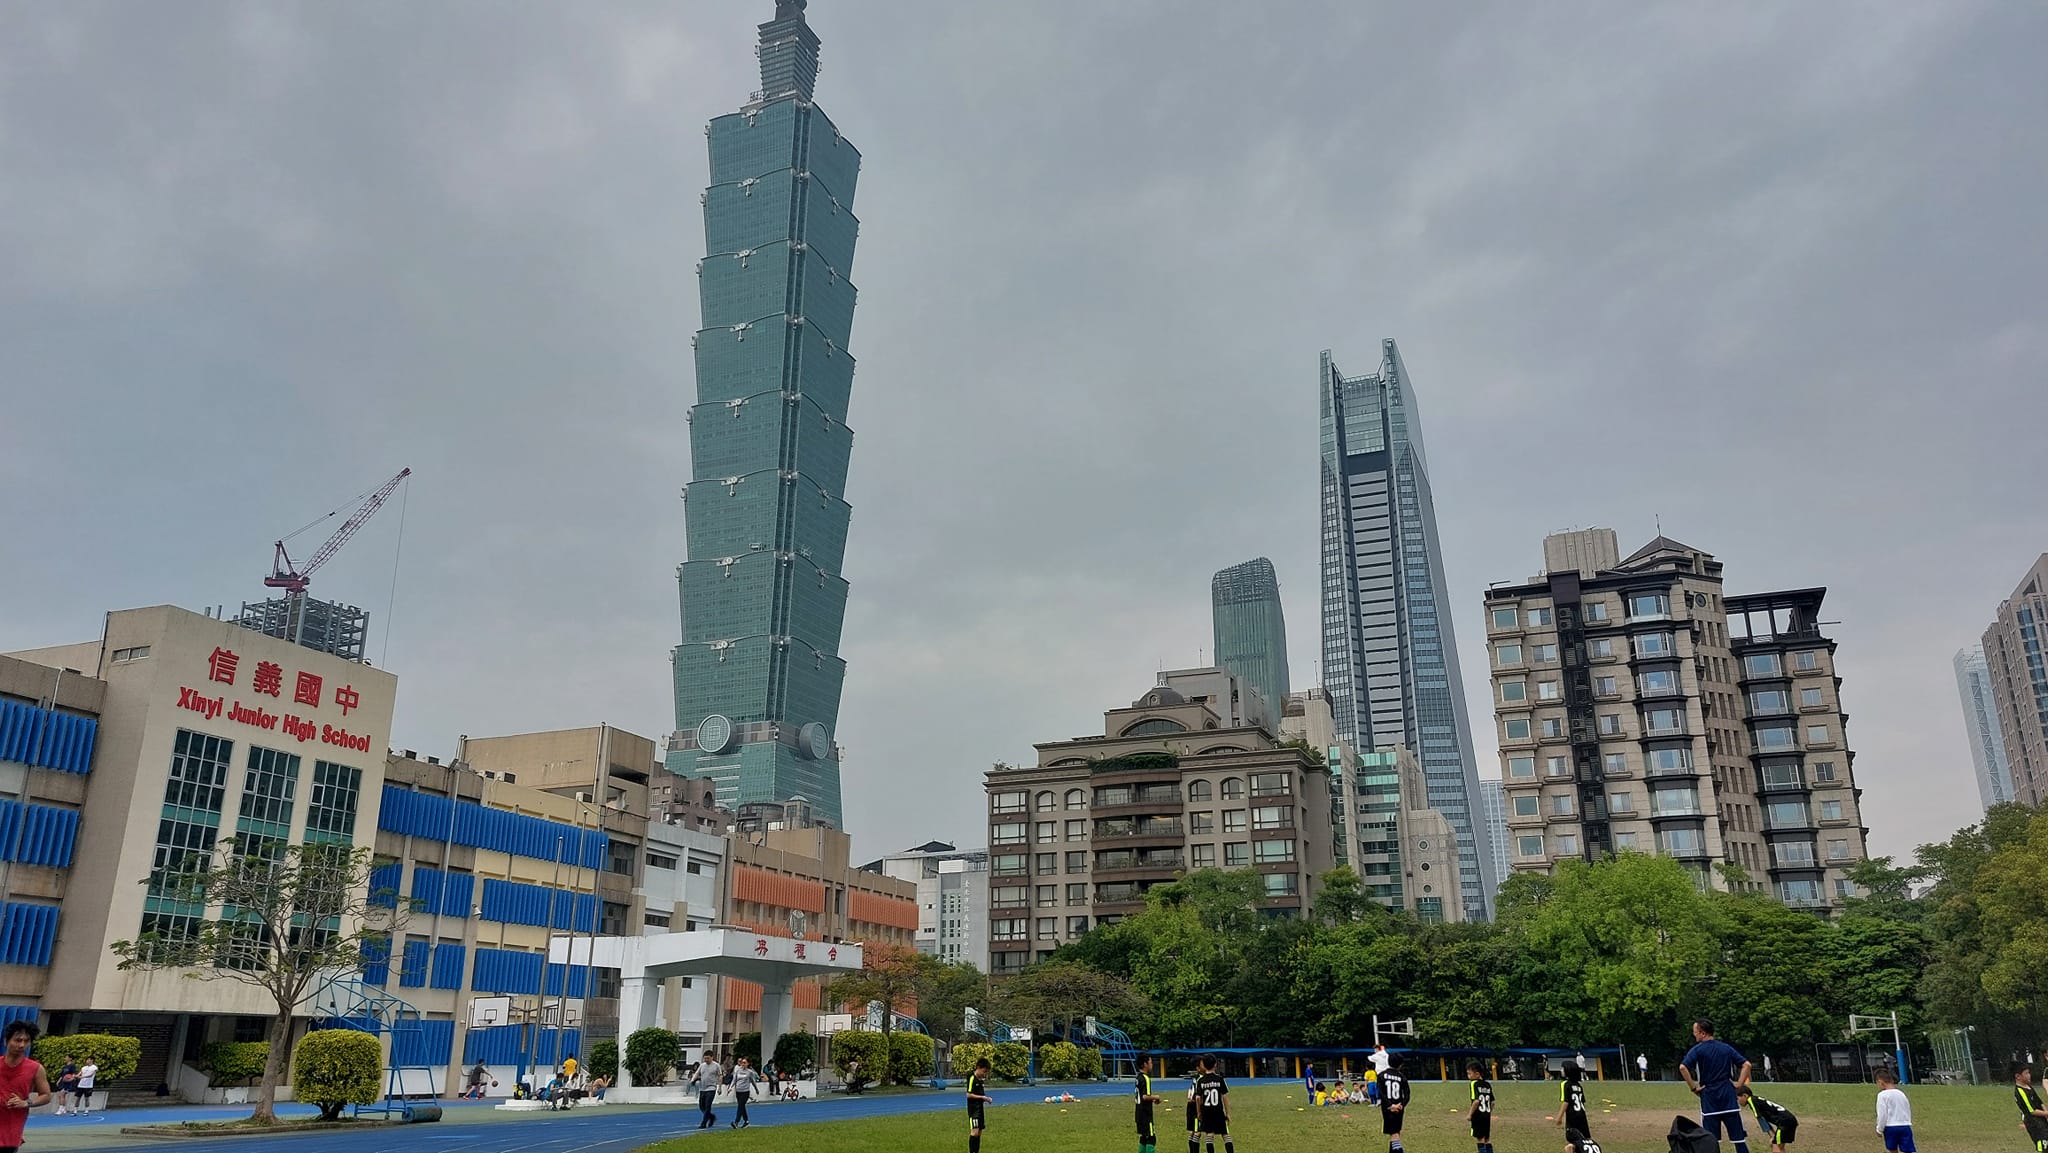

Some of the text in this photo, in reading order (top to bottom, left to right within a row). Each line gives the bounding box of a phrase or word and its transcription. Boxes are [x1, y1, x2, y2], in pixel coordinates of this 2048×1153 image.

[208, 646, 359, 716] 信義國中
[177, 686, 371, 753] Xinyi Junior High School
[1203, 1088, 1219, 1106] 20
[1385, 1080, 1400, 1100] 18
